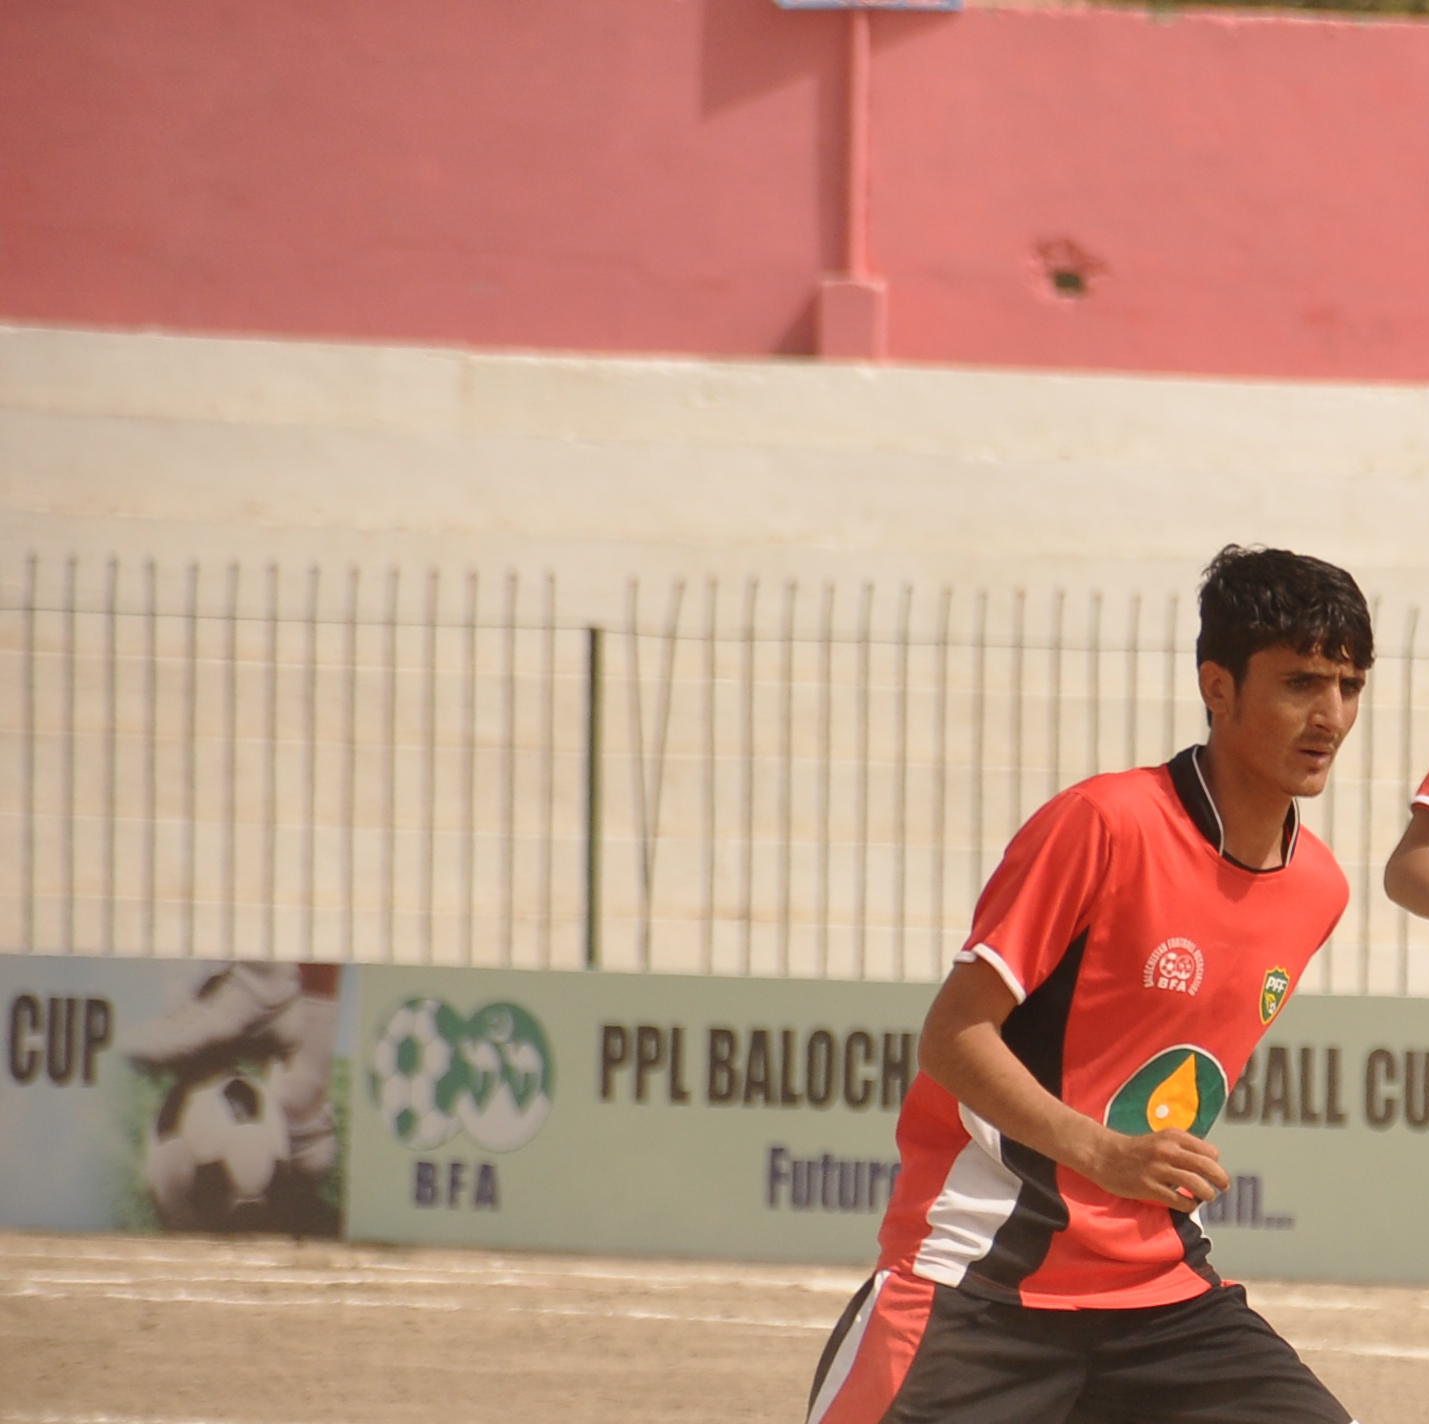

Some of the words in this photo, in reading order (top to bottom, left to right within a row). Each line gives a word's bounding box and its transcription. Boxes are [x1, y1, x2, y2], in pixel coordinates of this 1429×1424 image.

[1157, 976, 1187, 993] BFA
[1265, 976, 1287, 993] PFF
[6, 992, 113, 1085] CUP
[600, 1024, 691, 1104] PPL
[707, 1027, 915, 1109] BALOCH
[1225, 1045, 1347, 1127] BALL
[414, 1161, 499, 1211] BFA
